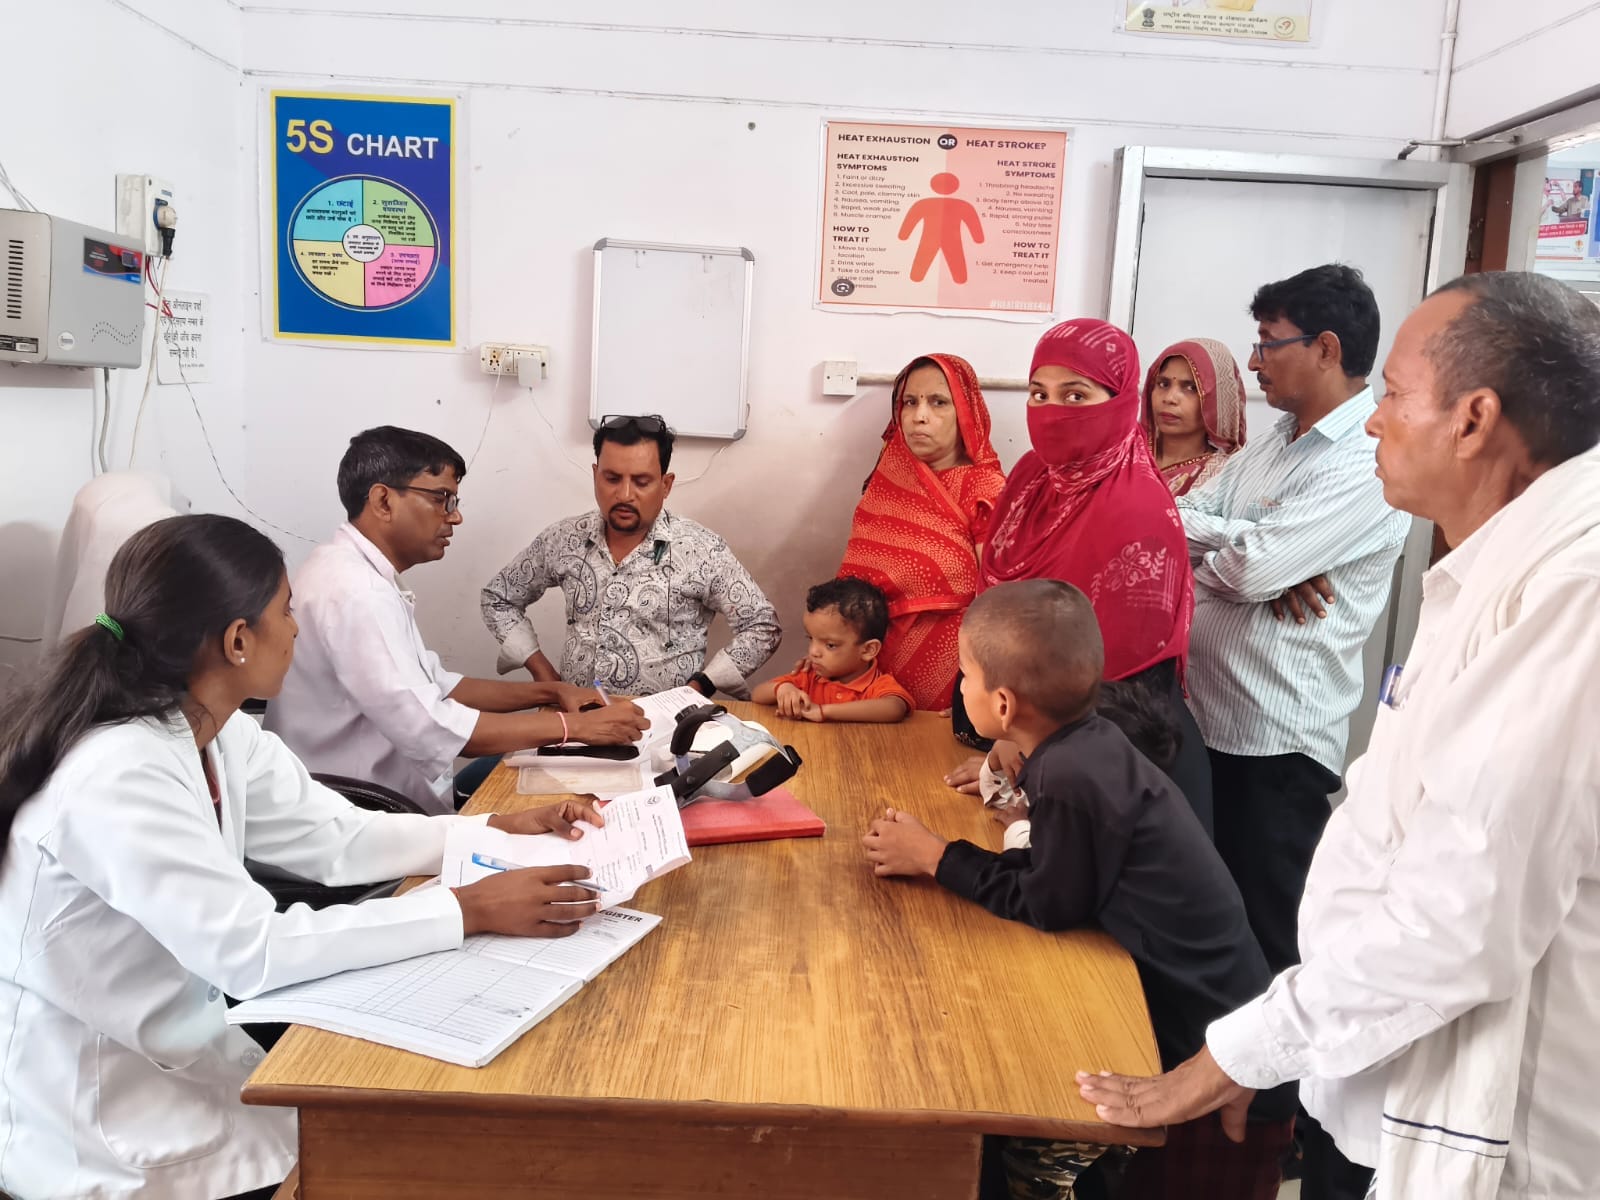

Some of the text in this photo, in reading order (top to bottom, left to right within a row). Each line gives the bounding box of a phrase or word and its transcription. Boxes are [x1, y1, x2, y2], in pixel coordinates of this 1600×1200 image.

[286, 119, 438, 160] 5S CHART
[838, 134, 931, 145] HEAT EXHAUSTION
[940, 138, 956, 146] OR
[966, 139, 1046, 150] HEAT STROKE?
[862, 154, 919, 162] EXHAUSTION
[1005, 170, 1056, 178] SYMPTOMS
[598, 910, 644, 922] EGISTER
